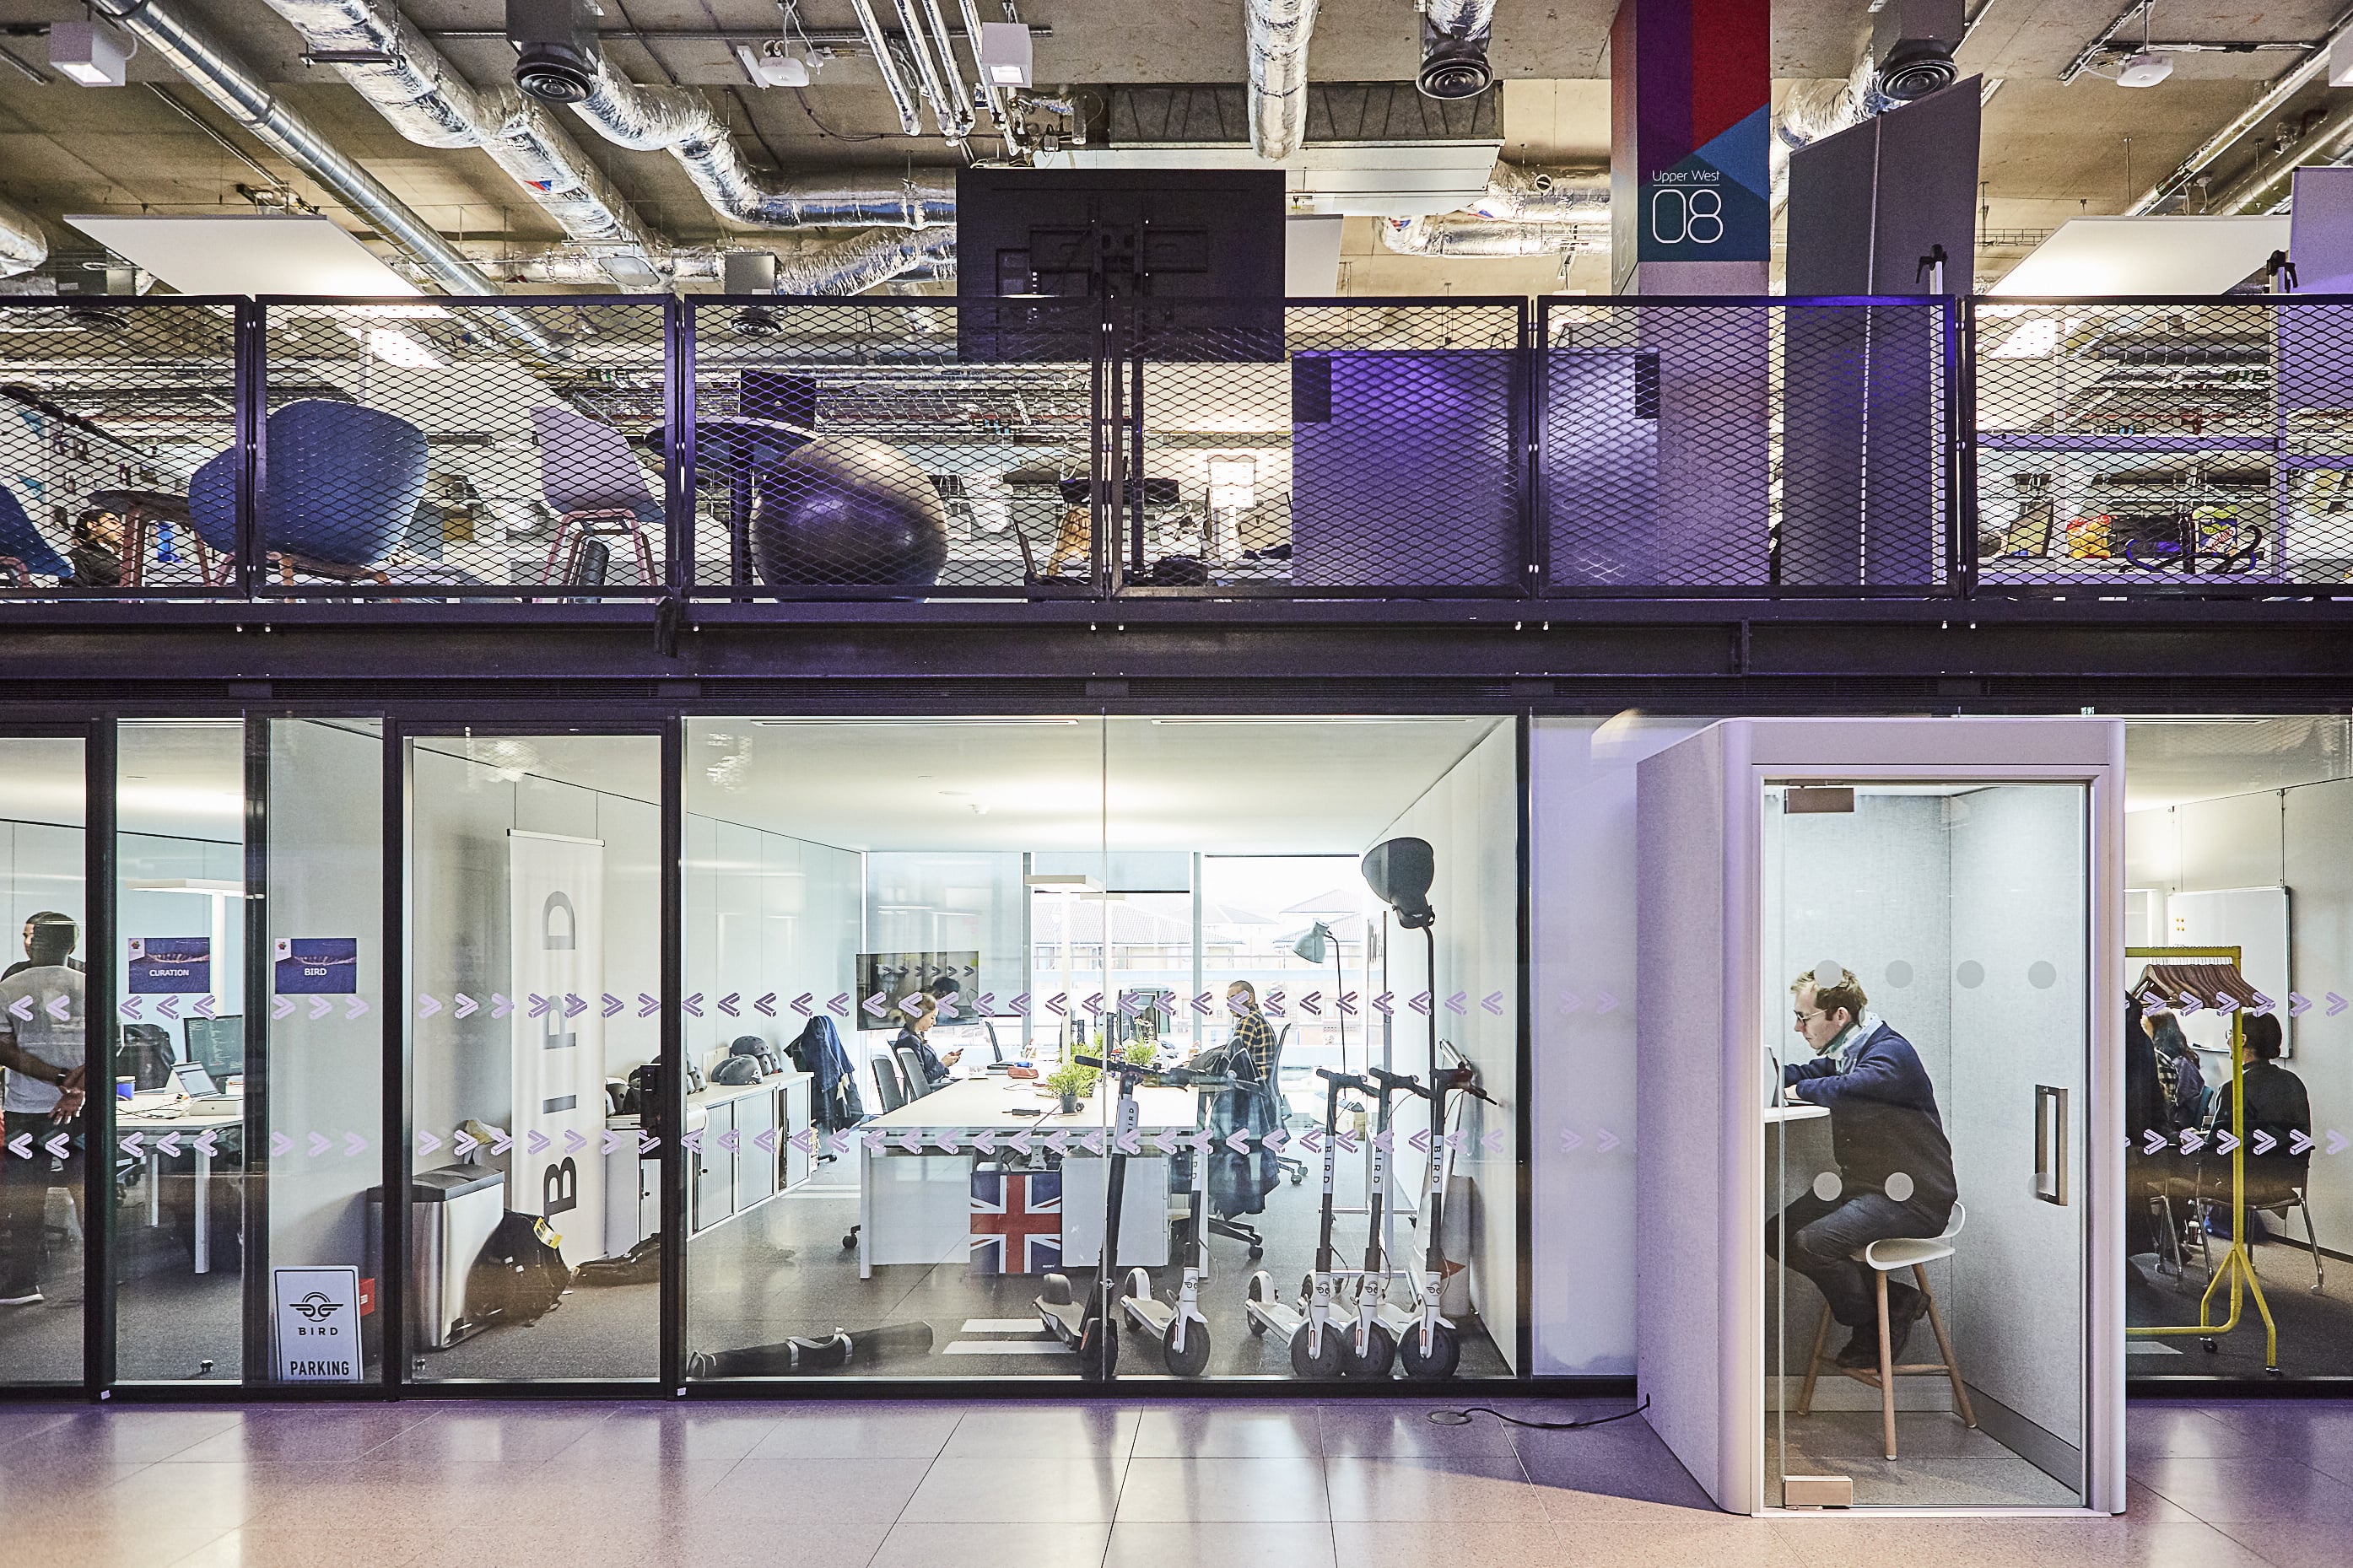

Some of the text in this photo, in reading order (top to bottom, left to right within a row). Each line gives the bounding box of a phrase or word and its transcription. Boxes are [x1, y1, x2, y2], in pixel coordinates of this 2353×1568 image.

[1652, 170, 1720, 184] Upper West
[1652, 188, 1724, 244] 08
[304, 967, 327, 976] BIRD
[542, 891, 577, 1222] BIRD
[1323, 1145, 1332, 1184] BIRD
[1433, 1145, 1442, 1183] BIRD
[297, 1327, 338, 1336] BIRD
[289, 1361, 350, 1377] PARKING
